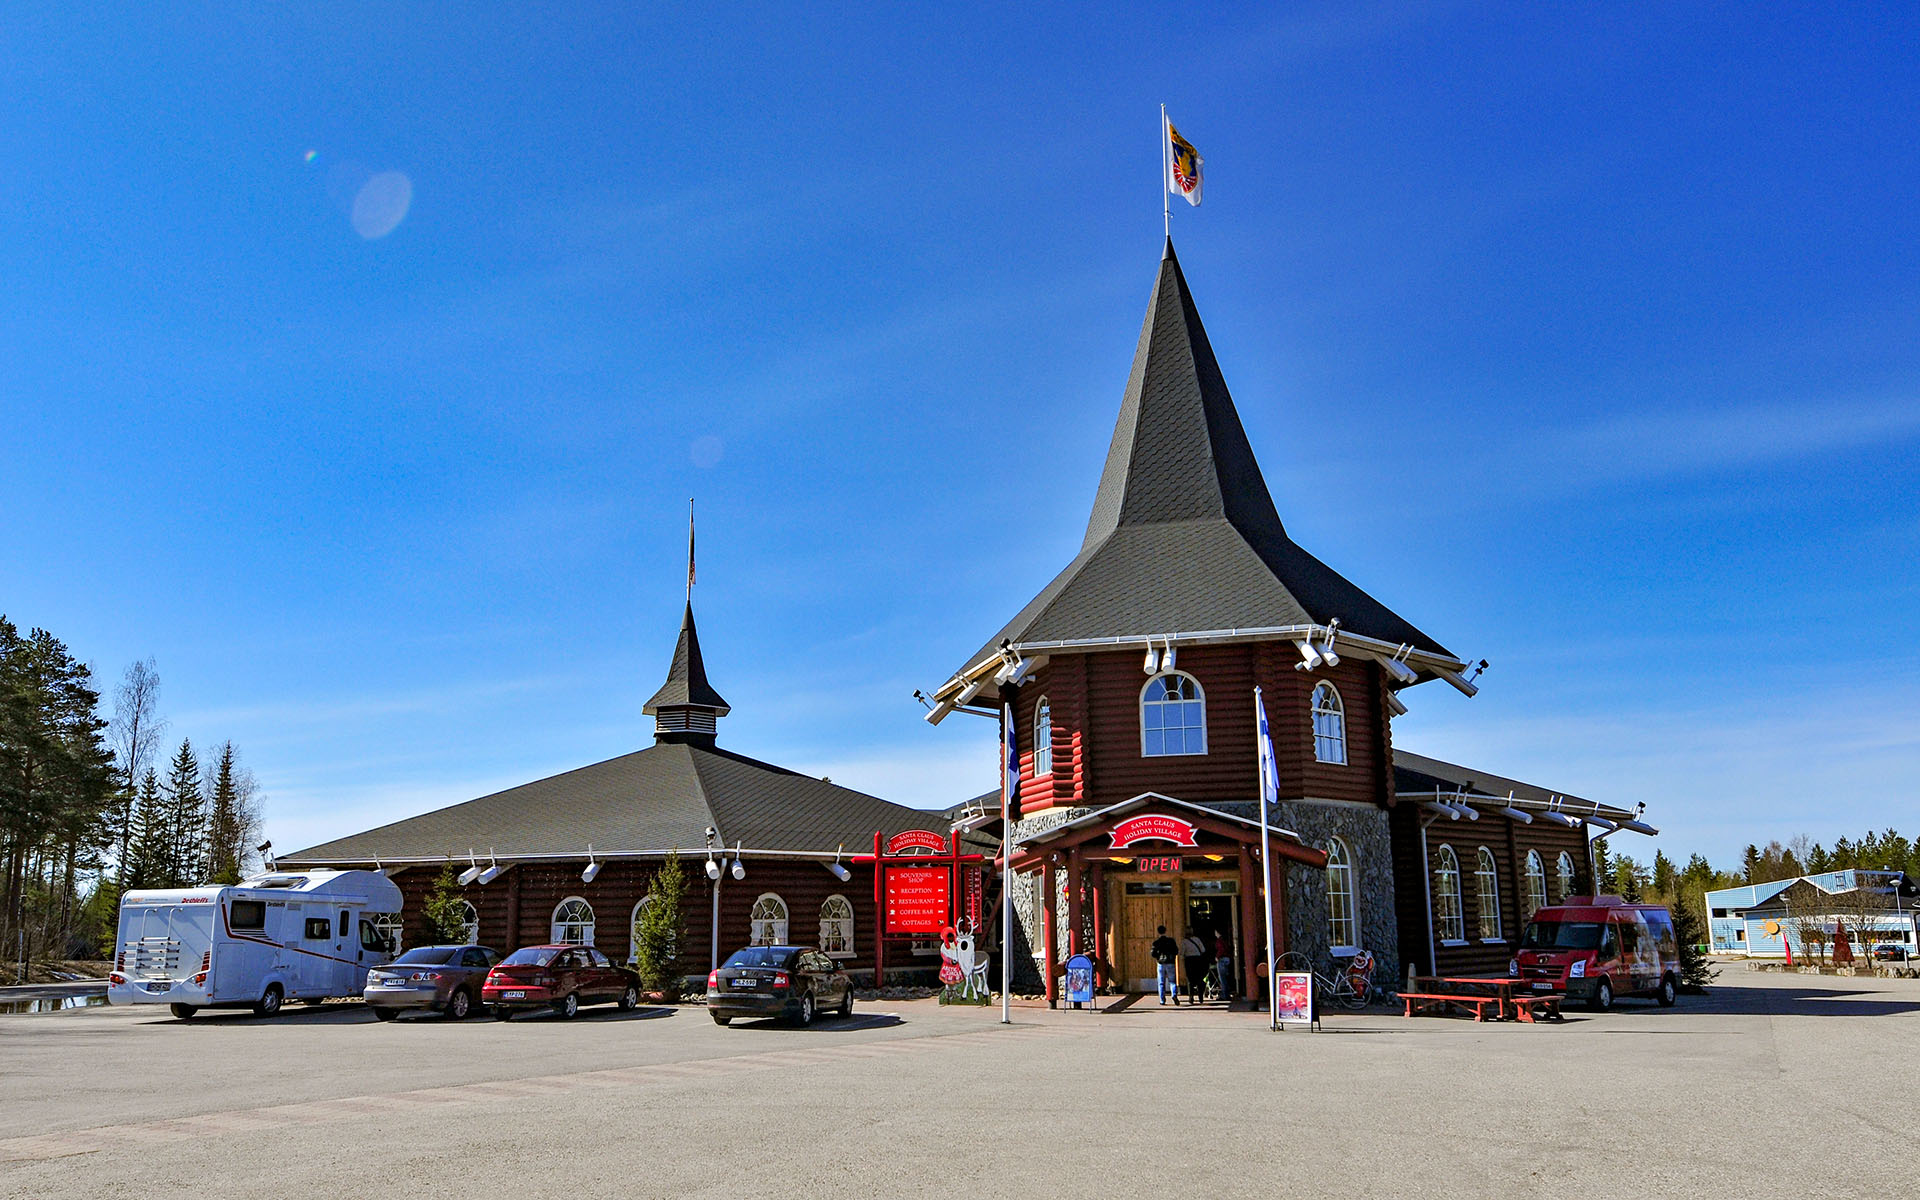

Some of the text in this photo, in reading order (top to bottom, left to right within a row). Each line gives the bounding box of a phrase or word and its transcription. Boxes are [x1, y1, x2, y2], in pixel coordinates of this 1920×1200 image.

[1131, 820, 1175, 830] SANTA CLAUS
[899, 832, 934, 840] SANTA CLAUS
[1124, 828, 1182, 840] HOLIDAY VILLAGE
[893, 838, 940, 848] HOLIDAY VILLAGE
[1140, 858, 1180, 872] OPEN
